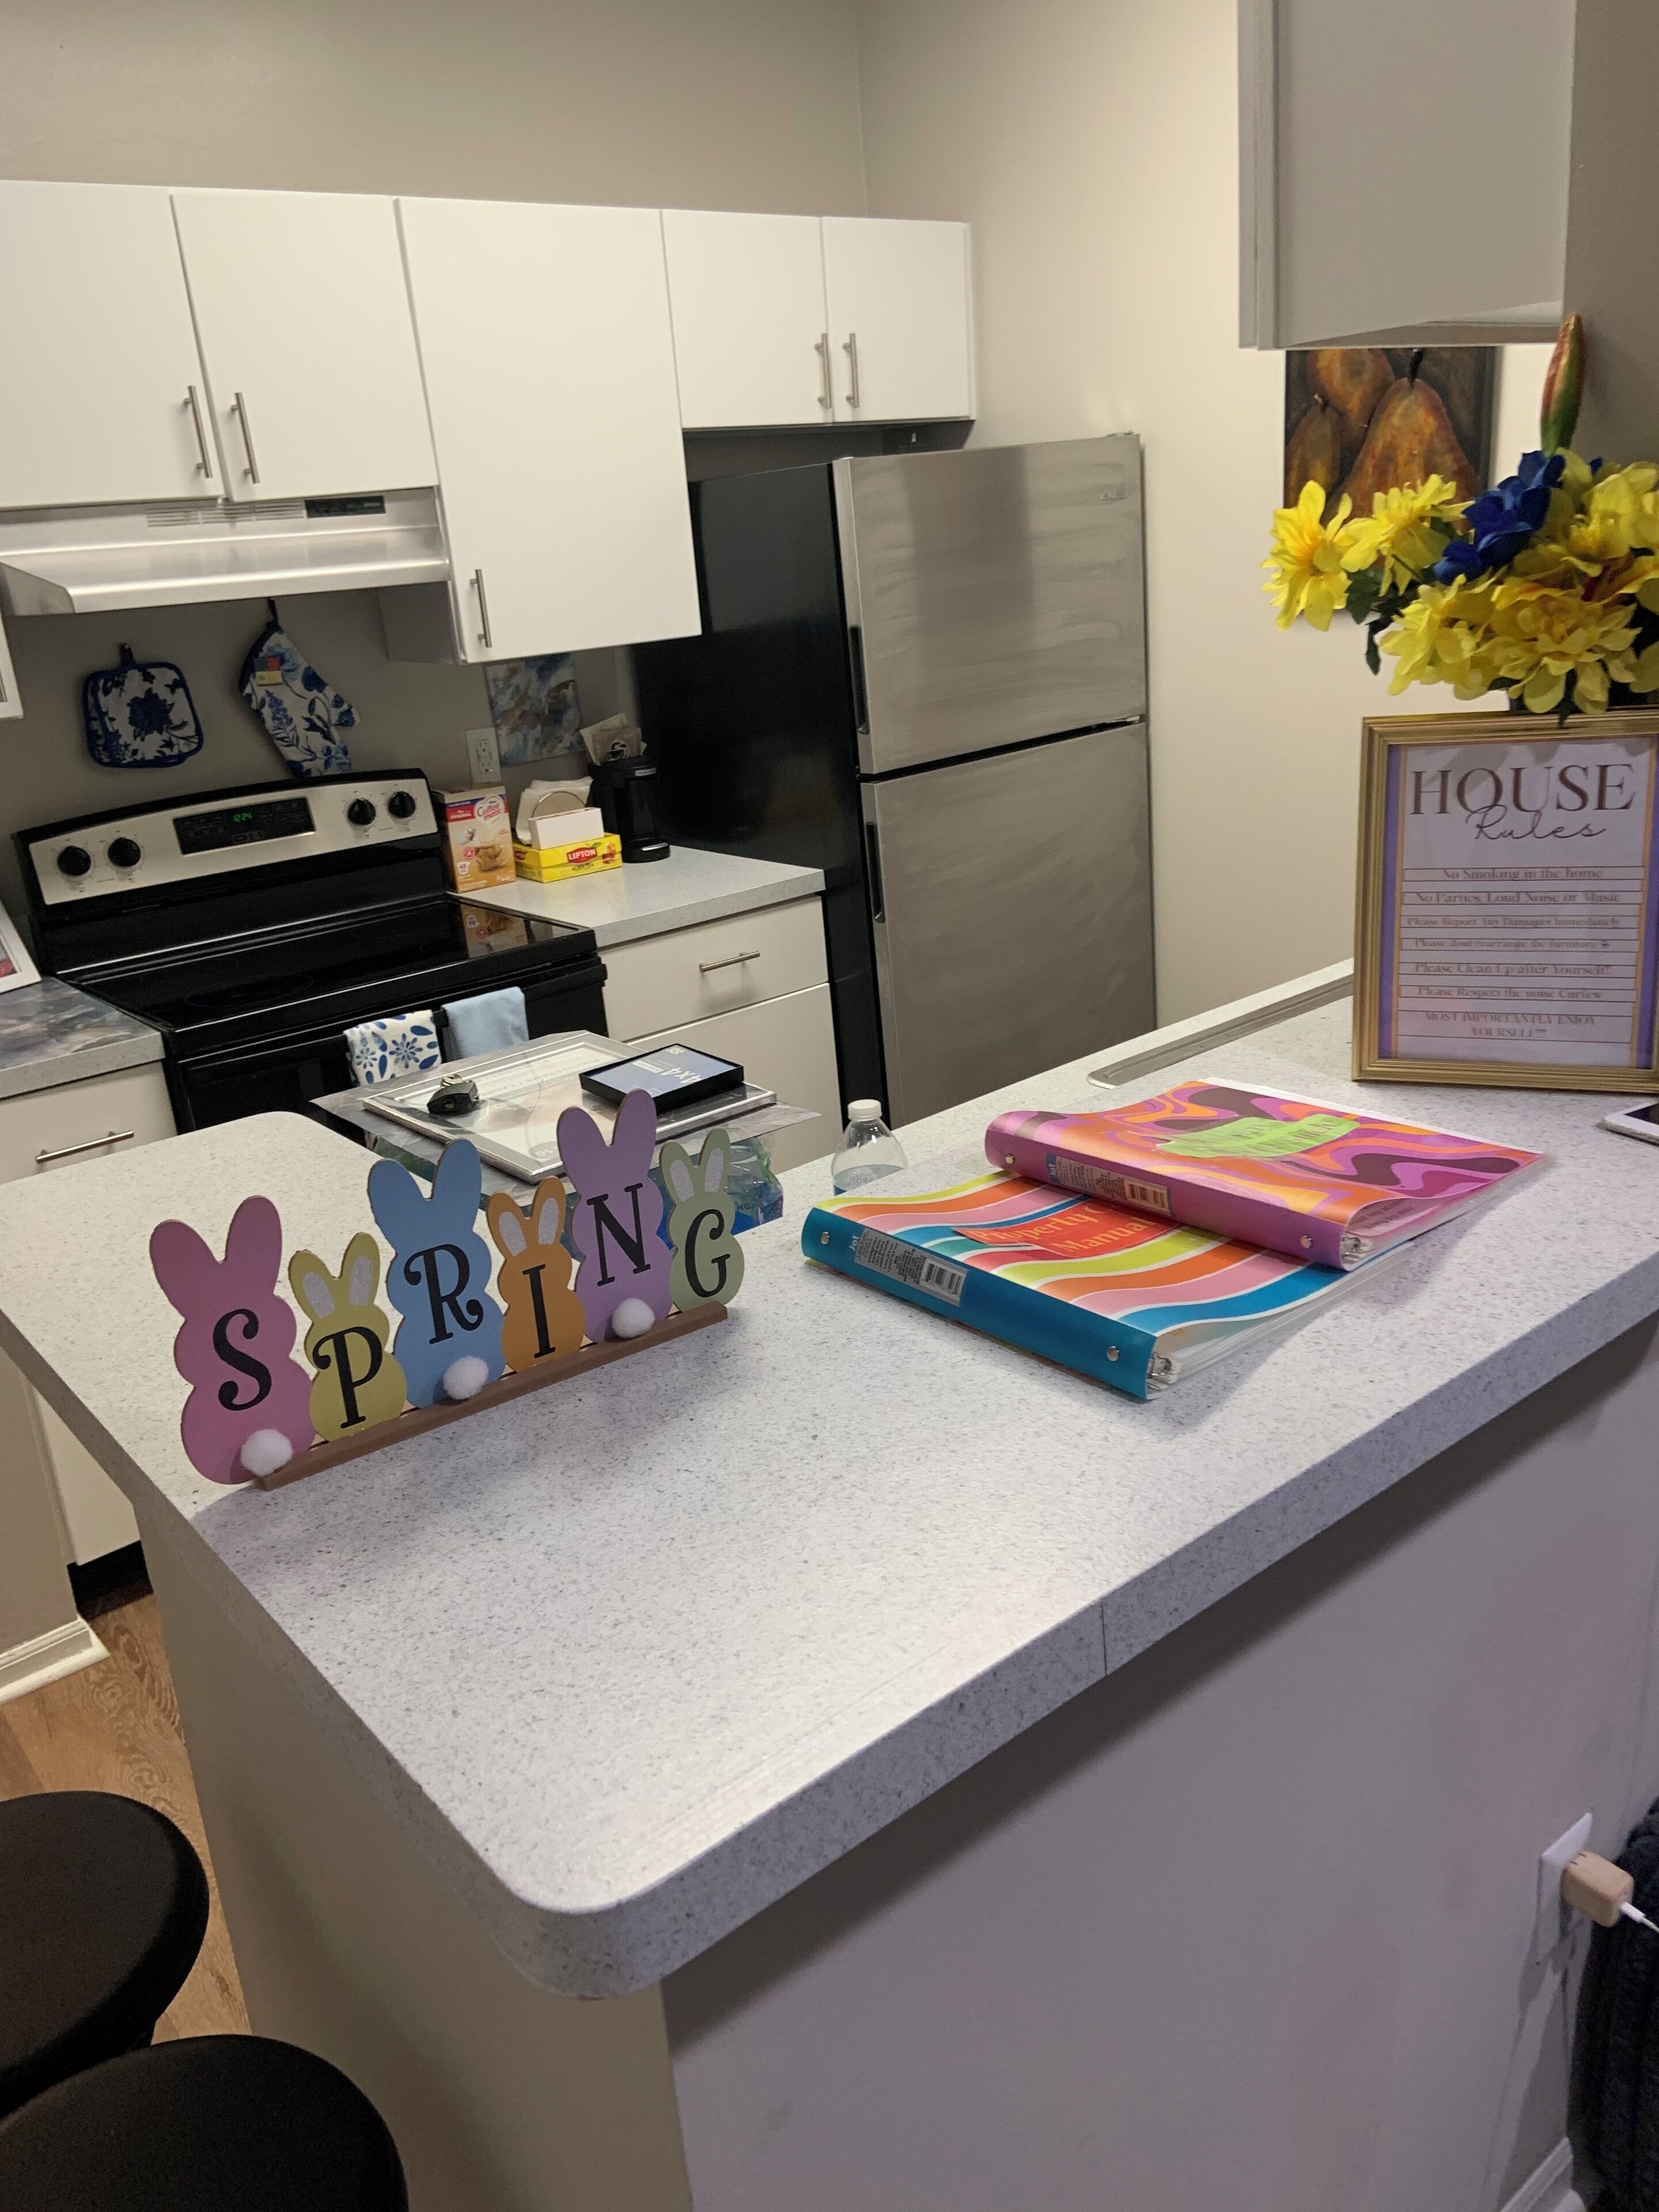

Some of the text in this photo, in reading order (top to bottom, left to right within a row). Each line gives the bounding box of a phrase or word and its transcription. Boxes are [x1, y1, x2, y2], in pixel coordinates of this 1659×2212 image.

[1410, 764, 1637, 815] HOUSE
[477, 803, 500, 817] Coffee
[1465, 805, 1607, 840] Rules
[568, 848, 596, 861] LIPTON
[1442, 869, 1459, 879] No
[1463, 868, 1520, 881] Smoking
[1540, 868, 1562, 878] the
[1565, 868, 1604, 878] home
[1416, 893, 1433, 903] No
[1487, 892, 1520, 903] Loud
[1525, 892, 1560, 903] Noise
[1584, 892, 1622, 903] Music
[1407, 917, 1438, 926] Please
[1442, 917, 1477, 927] Report
[1414, 938, 1448, 948] Please
[1475, 940, 1527, 950] rearrange
[1530, 940, 1548, 948] the
[1415, 963, 1453, 973] Please
[1456, 963, 1493, 974] Clean
[1418, 986, 1454, 997] Please
[1456, 987, 1500, 999] Respect
[1505, 988, 1521, 998] the
[1424, 1012, 1596, 1026] MOST IMPORTANTLY ENJOY
[966, 1207, 1097, 1242] Property
[1050, 1216, 1157, 1252] Manual
[848, 1235, 861, 1251] Jot
[213, 1183, 731, 1430] SPRING
